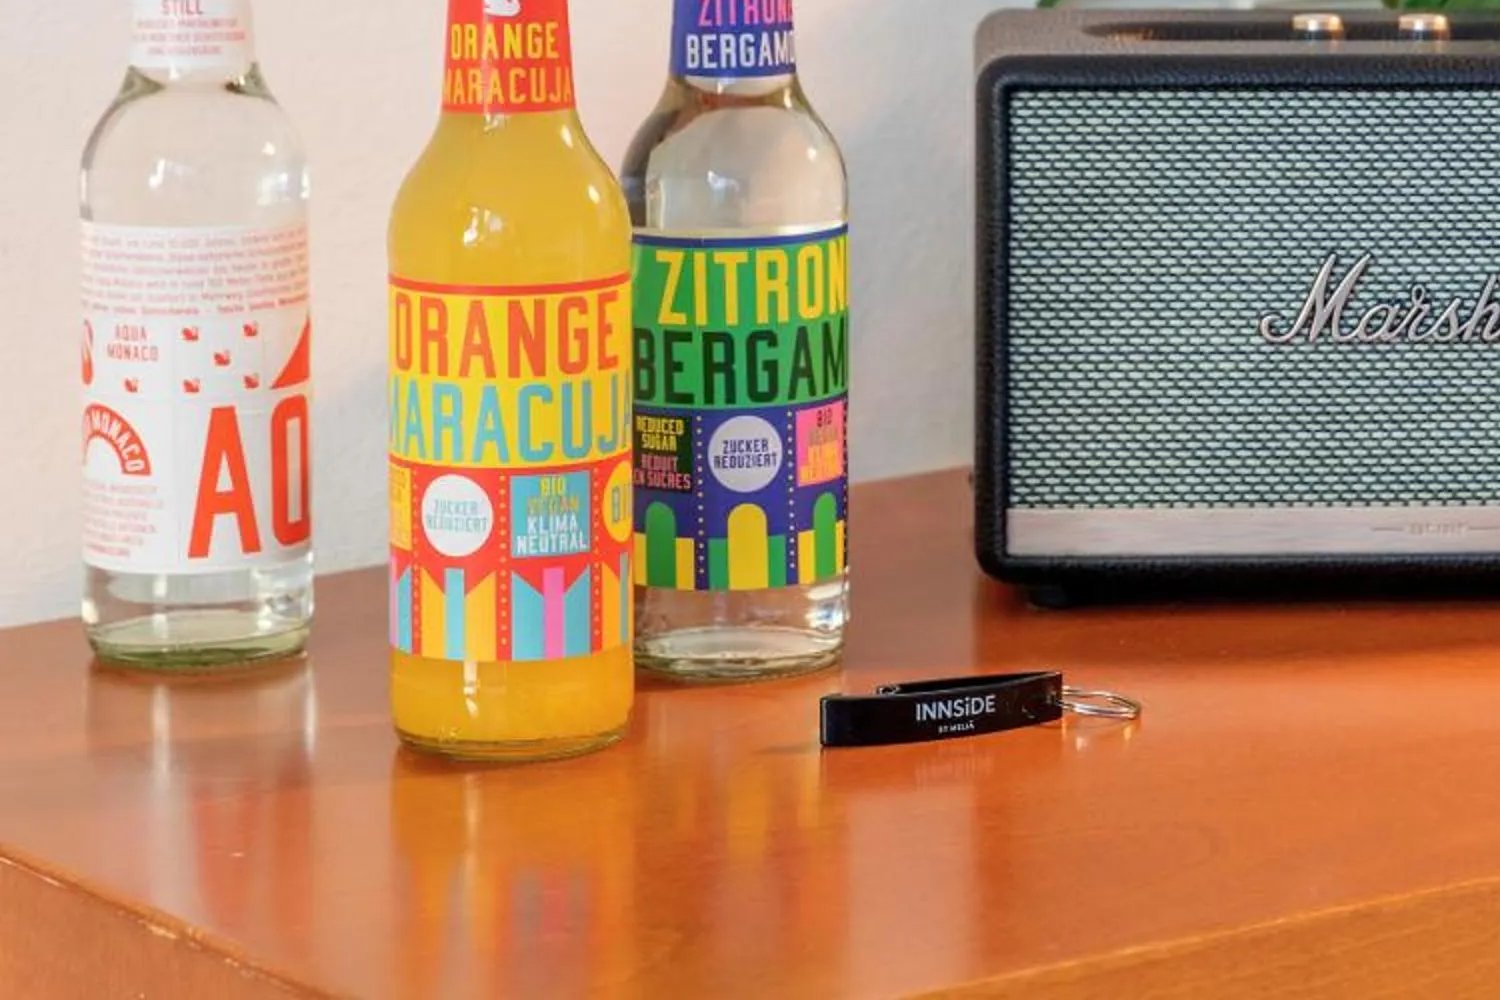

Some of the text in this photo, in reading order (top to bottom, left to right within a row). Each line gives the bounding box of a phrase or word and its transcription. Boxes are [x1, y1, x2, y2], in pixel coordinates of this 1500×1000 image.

[450, 21, 560, 61] ORANGE
[114, 323, 147, 341] AQUA
[395, 289, 619, 379] ORANGE
[106, 344, 160, 362] MONACO
[722, 438, 769, 455] ZUCKER
[713, 451, 778, 469] REDUZIERT
[527, 512, 579, 535] KLIMA
[516, 531, 590, 555] NEUTRAL
